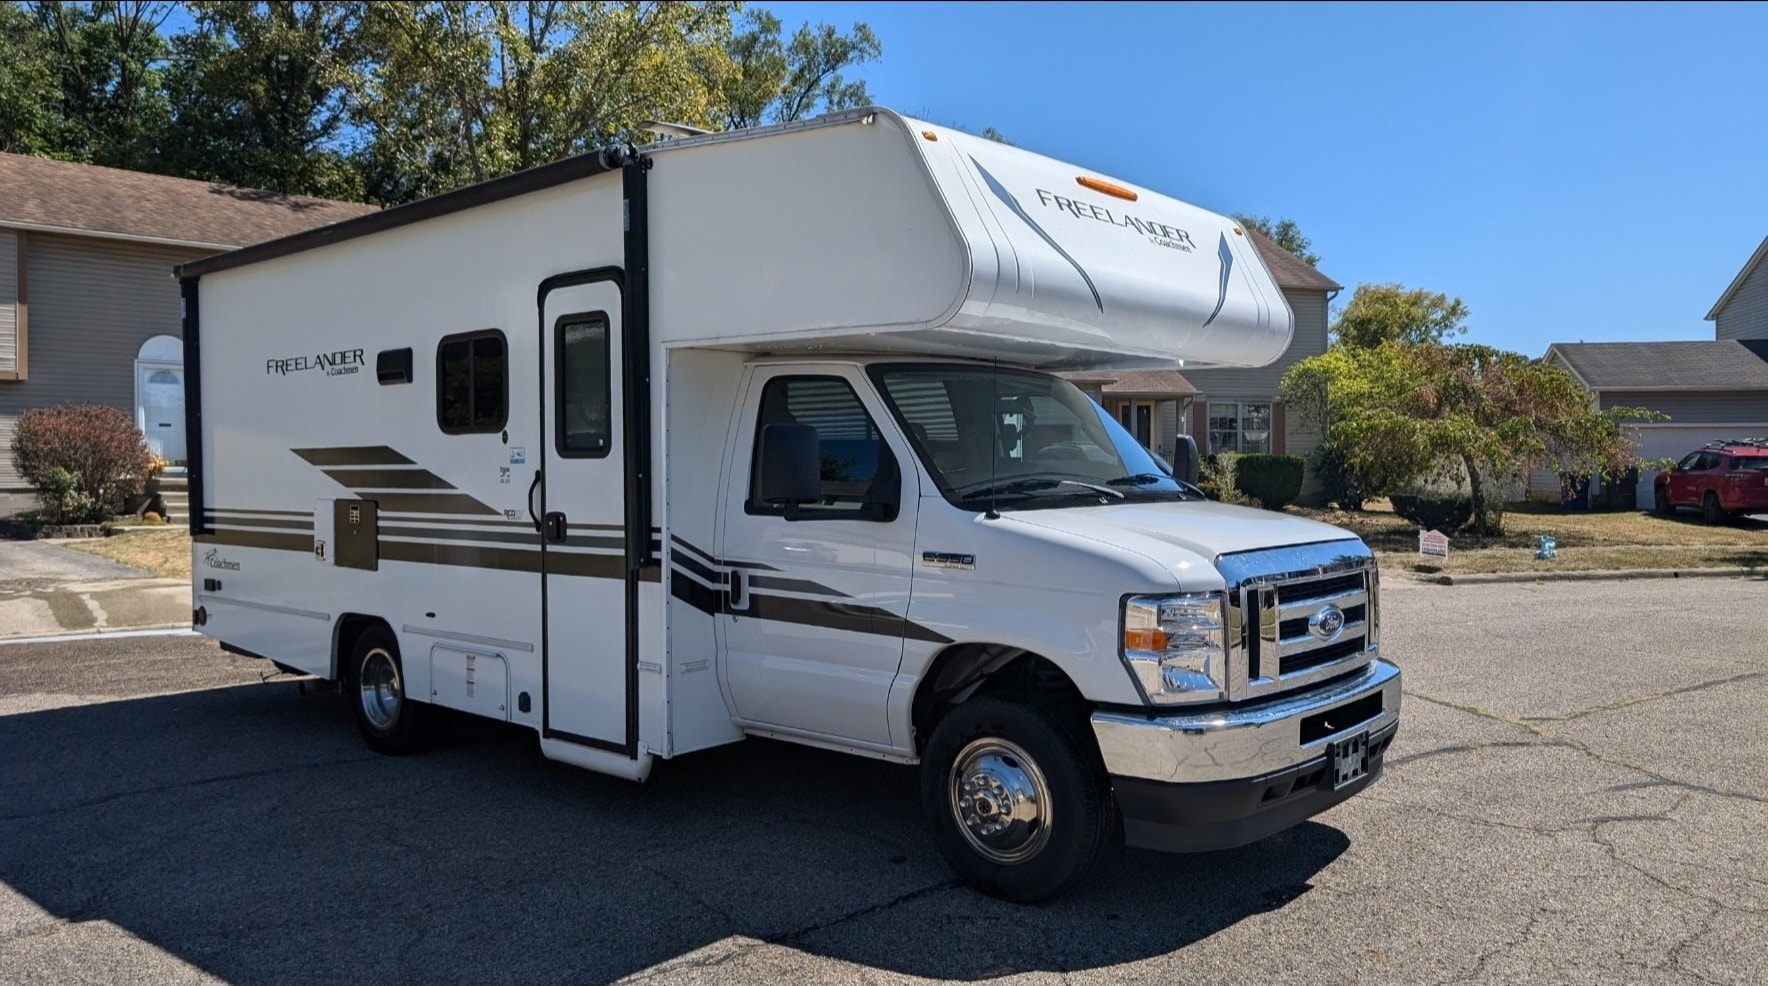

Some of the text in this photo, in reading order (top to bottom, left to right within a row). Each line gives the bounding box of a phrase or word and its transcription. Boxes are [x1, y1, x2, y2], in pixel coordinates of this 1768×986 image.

[1035, 188, 1197, 248] FREELANDER
[266, 348, 365, 376] FREELANDER
[331, 365, 359, 377] Coachmen
[209, 557, 241, 571] Coachmen
